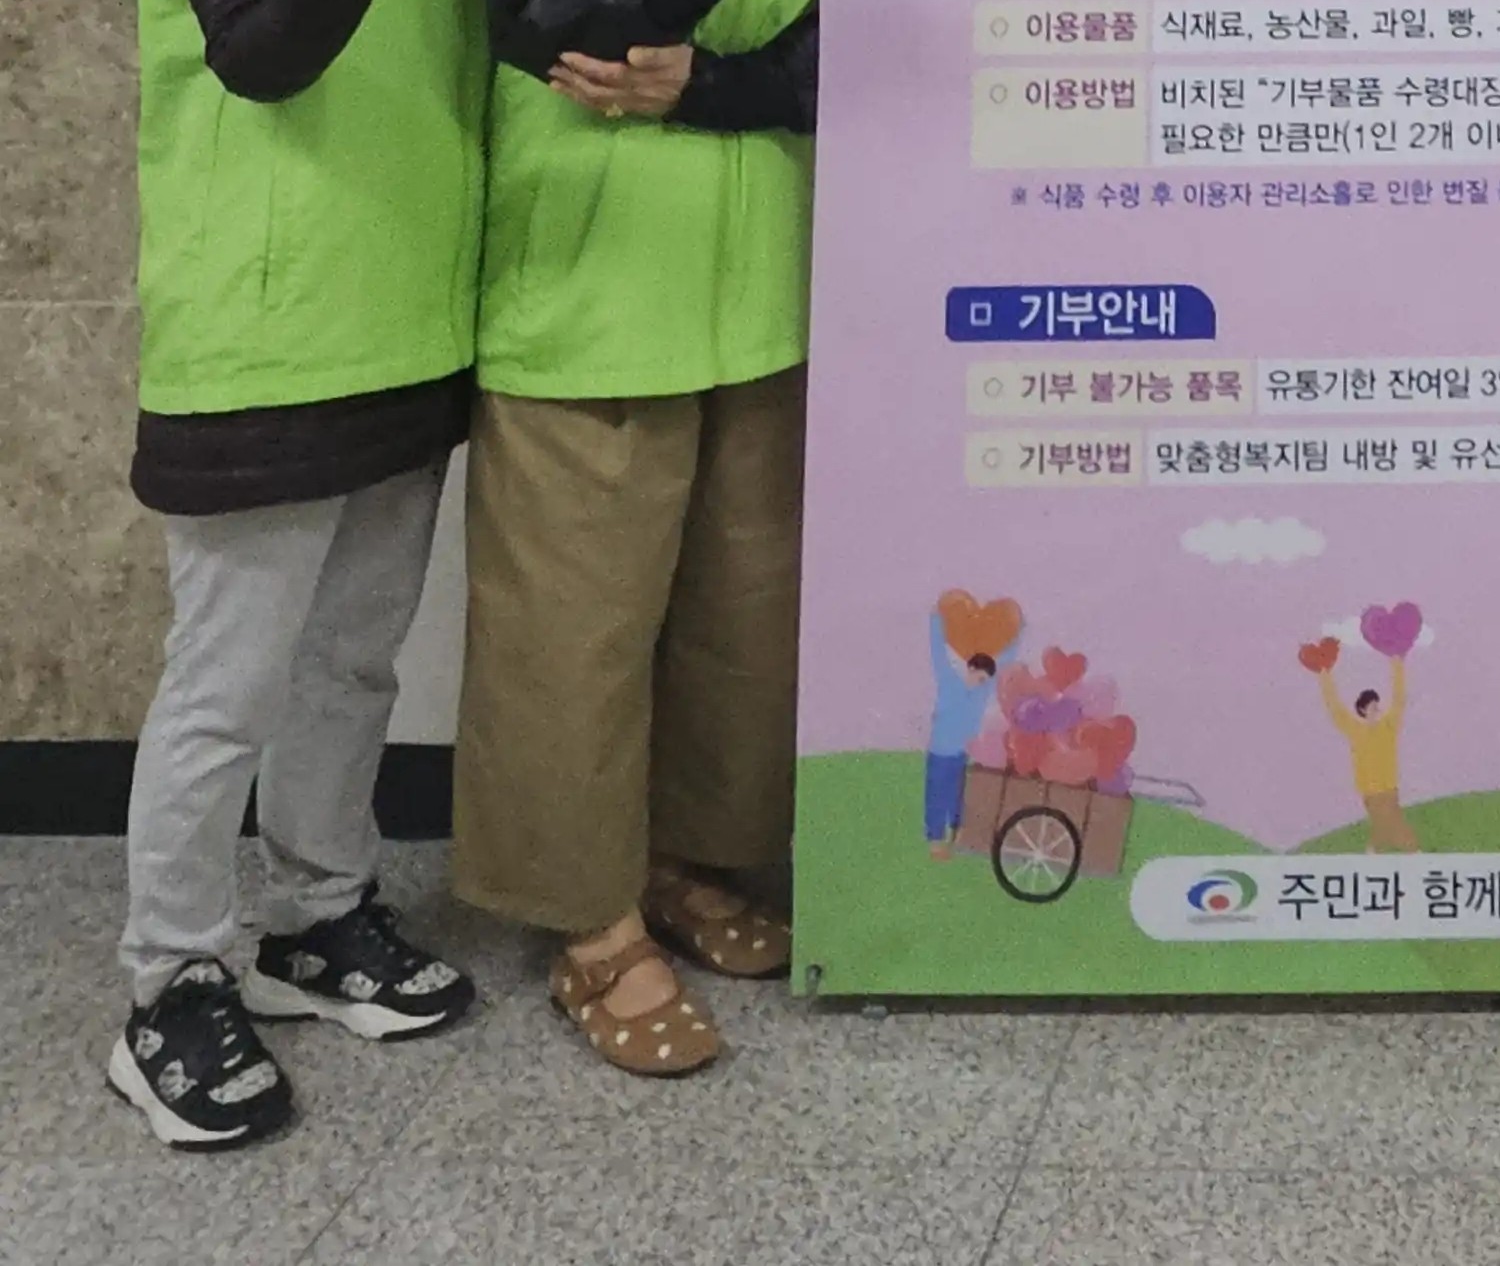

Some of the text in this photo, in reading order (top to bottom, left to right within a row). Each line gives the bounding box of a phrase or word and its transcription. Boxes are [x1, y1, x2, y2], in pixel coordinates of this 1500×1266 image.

[1025, 10, 1139, 43] 이용물품
[1160, 8, 1255, 41] 식재료,
[1265, 8, 1359, 41] 농산물,
[1370, 9, 1435, 40] 과일,
[1447, 9, 1484, 40] 빵,
[1024, 77, 1137, 111] 이용방법
[1161, 77, 1247, 109] 비치된
[1160, 122, 1246, 155] 필요한
[1256, 120, 1398, 155] 만큼만(1인
[1408, 120, 1456, 153] 2개
[1039, 181, 1086, 210] 식품
[1096, 181, 1141, 210] 수령
[1150, 181, 1173, 208] 후
[1182, 180, 1252, 209] 이용자
[1260, 179, 1378, 208] 관리소홀로
[1386, 179, 1434, 207] 인한
[1443, 178, 1488, 207] 변질
[1017, 289, 1178, 337] 기부안내
[1019, 371, 1078, 404] 기부
[1087, 370, 1174, 404] 불가능
[1185, 370, 1243, 402] 품목
[1265, 368, 1377, 402] 유통기한
[1386, 367, 1471, 400] 잔여일
[1018, 441, 1133, 475] 기부방법
[1155, 438, 1330, 474] 맞춤형복지팀
[1341, 438, 1398, 472] 내방
[1411, 437, 1439, 471] 및
[1276, 871, 1404, 920] 주민과
